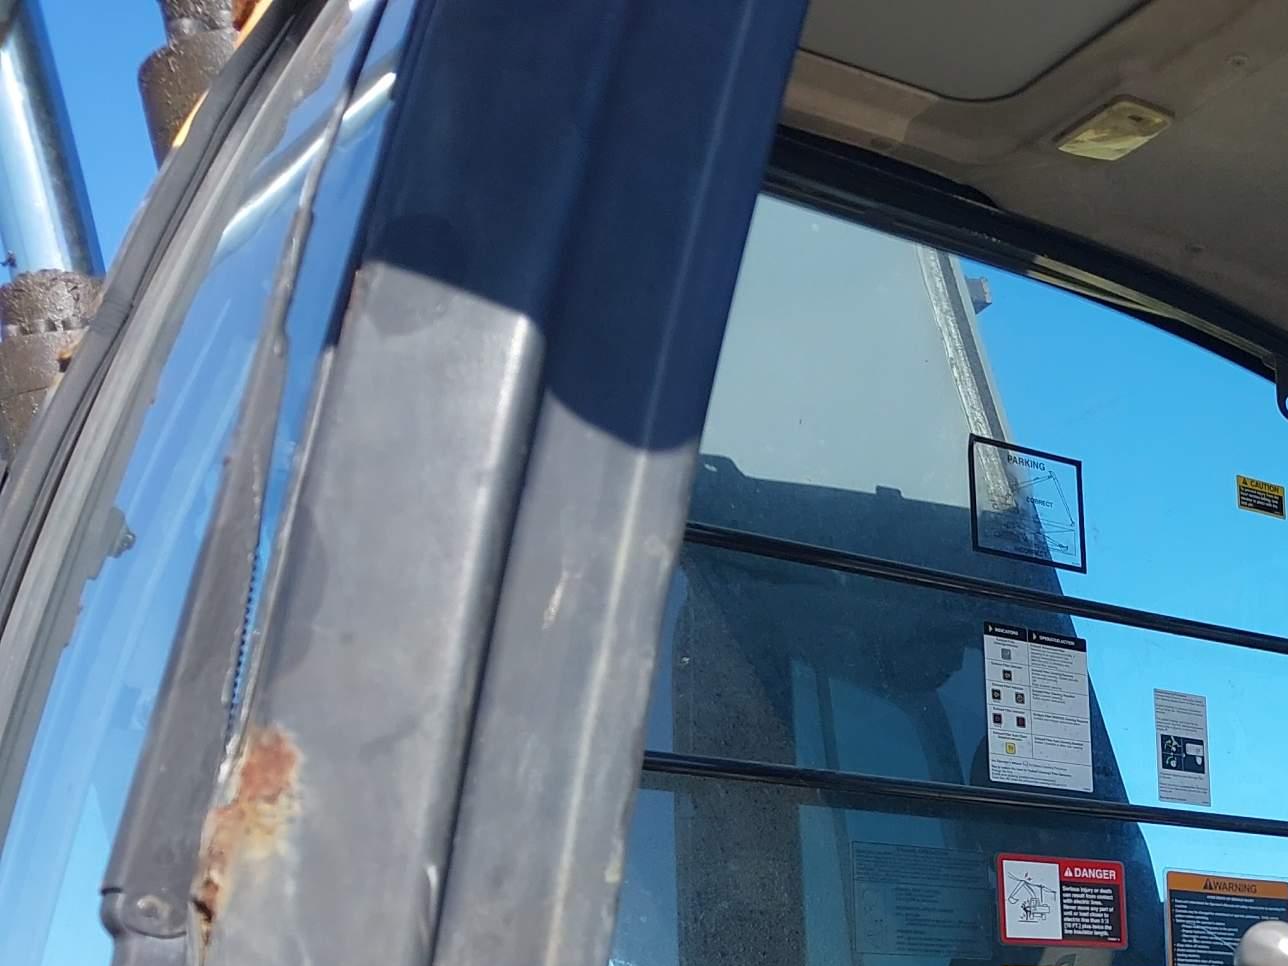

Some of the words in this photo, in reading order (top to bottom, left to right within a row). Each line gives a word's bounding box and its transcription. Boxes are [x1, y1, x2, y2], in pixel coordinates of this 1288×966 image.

[1007, 454, 1046, 471] PARKING
[1250, 479, 1280, 494] CAUTION
[1026, 496, 1054, 508] CORRECT
[1074, 867, 1116, 880] DANGER
[1213, 881, 1257, 893] WARNING
